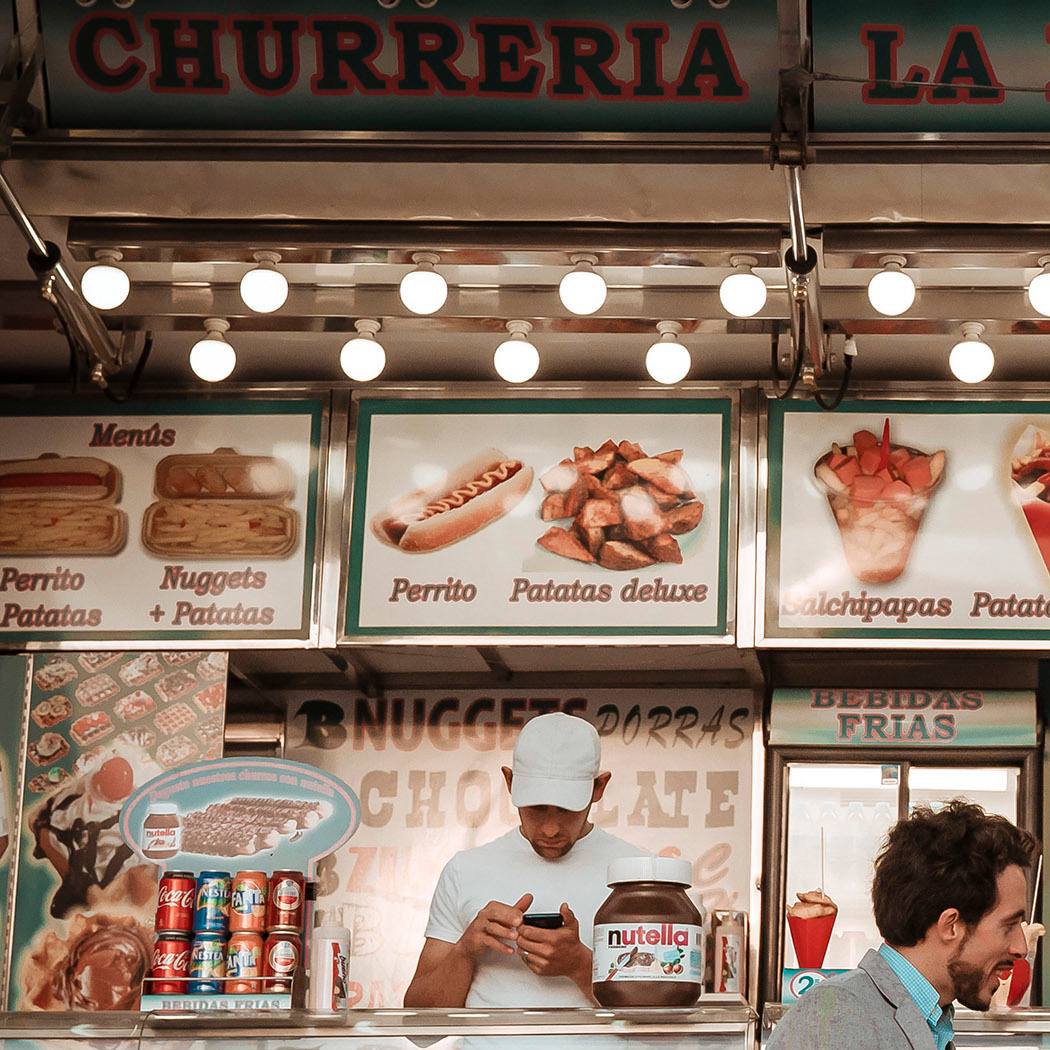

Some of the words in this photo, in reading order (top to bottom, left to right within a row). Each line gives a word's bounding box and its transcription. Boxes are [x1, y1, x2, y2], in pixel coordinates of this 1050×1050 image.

[70, 12, 749, 100] CHURRERIA
[860, 24, 1004, 104] LA
[89, 422, 176, 447] Menús
[0, 566, 85, 592] Perrito
[159, 565, 267, 596] Nuggets
[389, 576, 478, 604] Perrito
[510, 576, 612, 603] Patatas
[619, 576, 709, 603] deluxe
[2, 602, 103, 628] Patatas
[149, 604, 166, 624] +
[172, 601, 276, 626] Patatas
[781, 590, 952, 623] Salchipapas
[810, 689, 984, 711] BEBIDAS
[596, 703, 750, 749] PORRAS
[836, 713, 957, 743] FRIAS
[146, 828, 176, 837] nutella
[608, 923, 689, 946] nutella
[227, 952, 256, 970] ANTA
[162, 1000, 233, 1010] BEBIDAS
